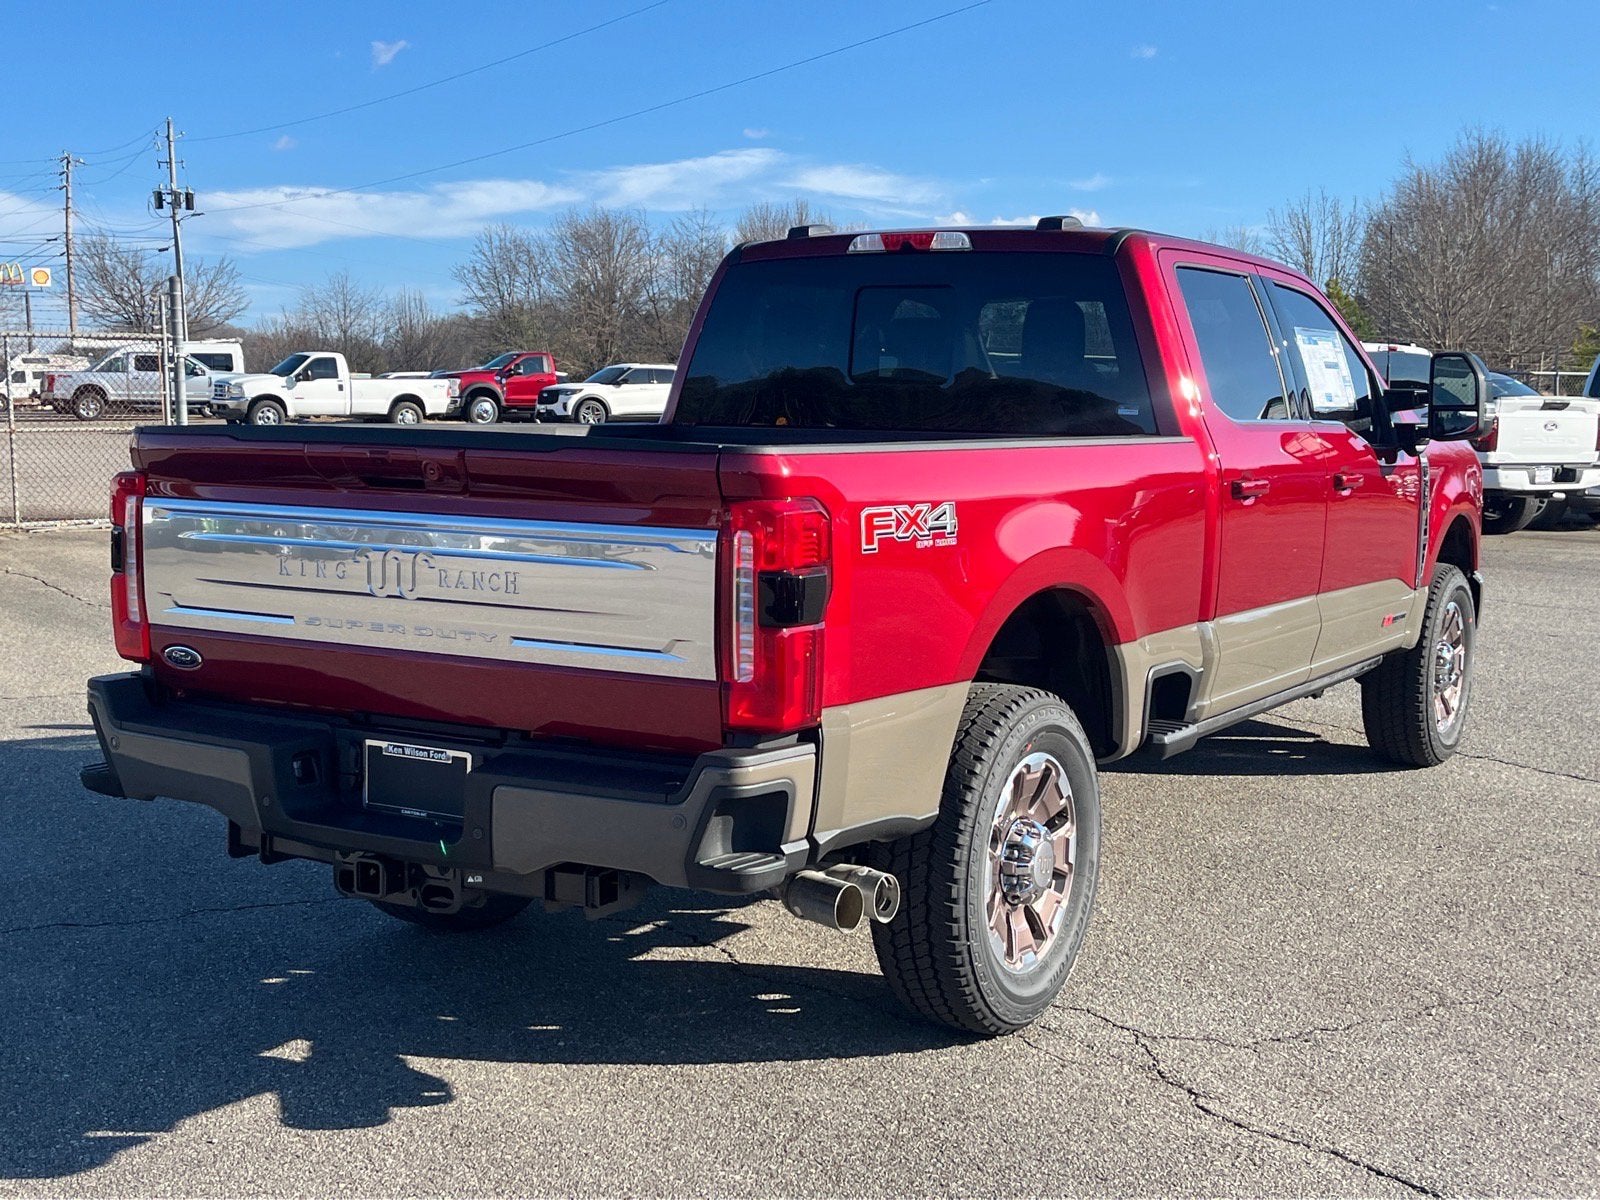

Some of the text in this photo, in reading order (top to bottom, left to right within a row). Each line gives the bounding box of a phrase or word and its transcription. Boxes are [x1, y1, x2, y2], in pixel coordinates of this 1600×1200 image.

[861, 502, 957, 553] FX4
[276, 554, 520, 595] KING RANCH
[304, 616, 498, 643] SUPER DUTY
[388, 744, 447, 760] Ken Wilson Ford
